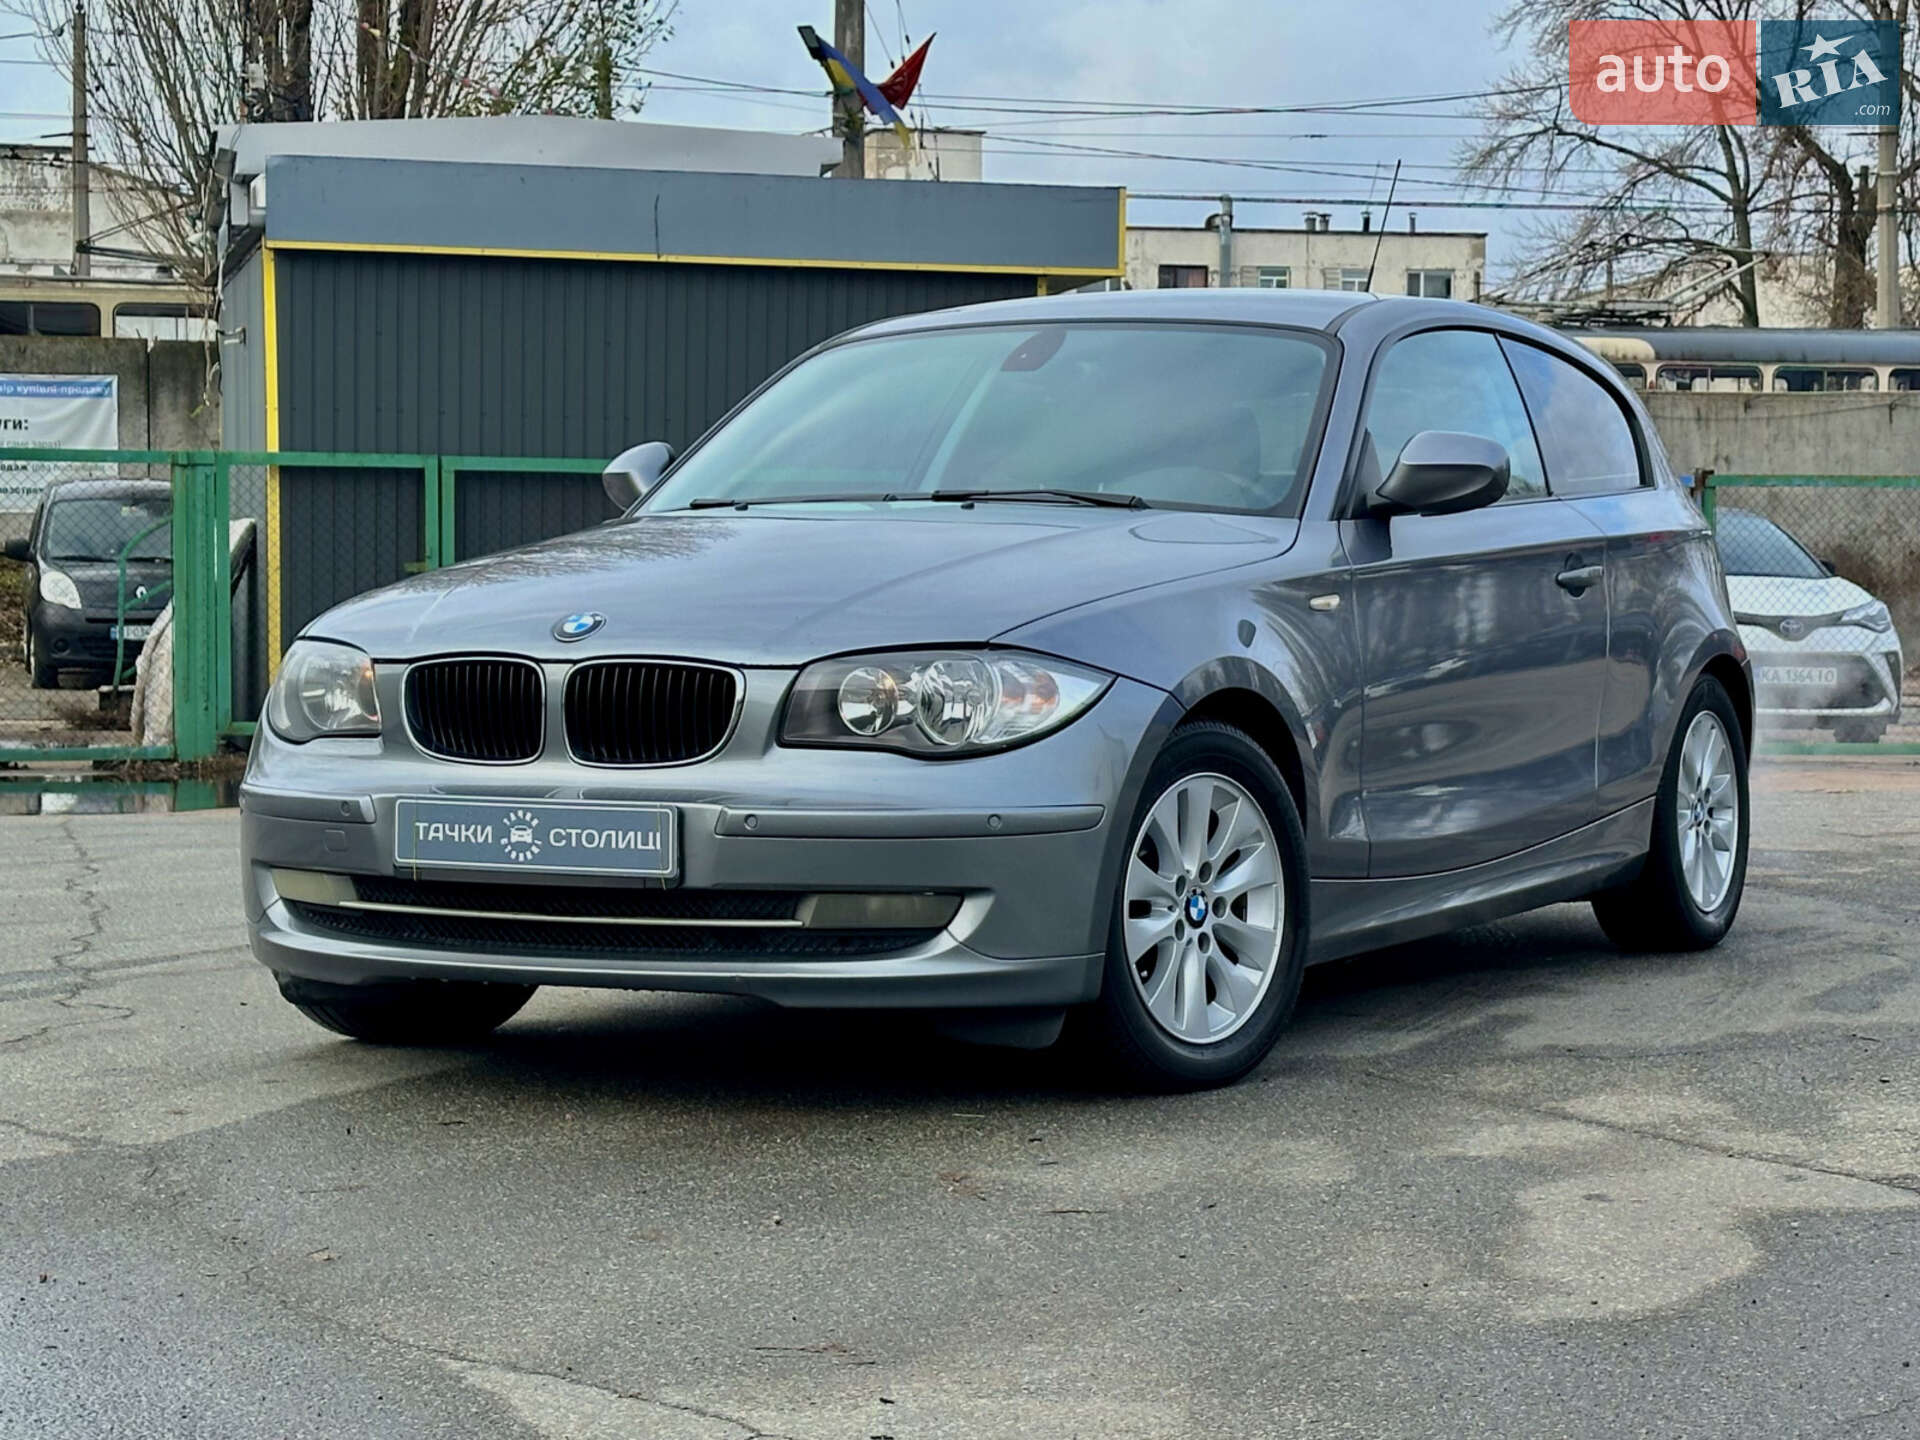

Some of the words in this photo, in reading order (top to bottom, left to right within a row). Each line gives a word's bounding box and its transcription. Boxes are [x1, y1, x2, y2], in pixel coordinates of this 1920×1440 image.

[0, 418, 29, 430] ги:
[415, 821, 493, 844] ТАЧКИ
[549, 827, 661, 850] СТОЛИЦІ
